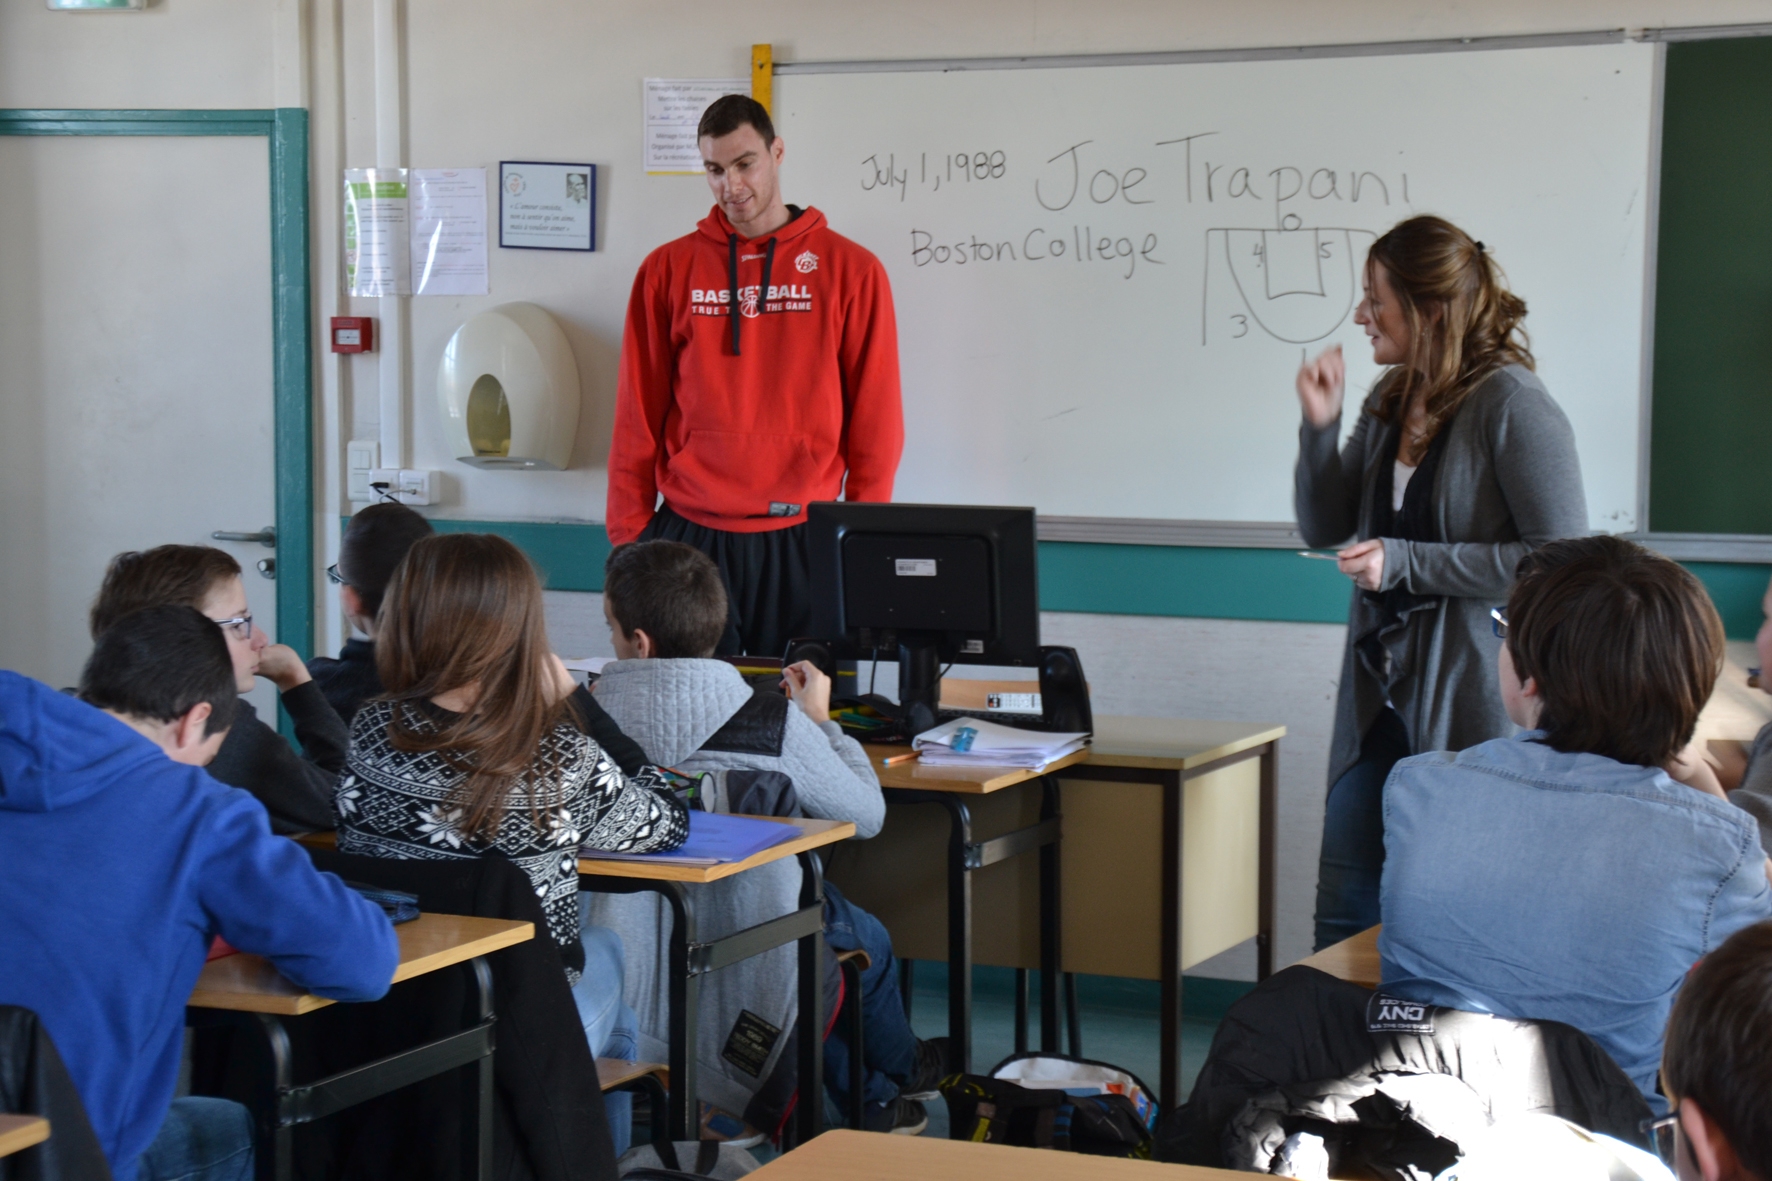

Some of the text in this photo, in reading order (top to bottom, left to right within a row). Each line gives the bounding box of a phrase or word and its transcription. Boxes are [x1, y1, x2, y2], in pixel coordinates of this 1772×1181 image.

[861, 153, 907, 202] July
[1035, 131, 1411, 235] Joe Trapani
[1320, 241, 1334, 259] 5
[692, 306, 719, 315] TRUE
[766, 303, 782, 312] THE
[785, 301, 811, 311] GAME
[1229, 313, 1249, 338] 3
